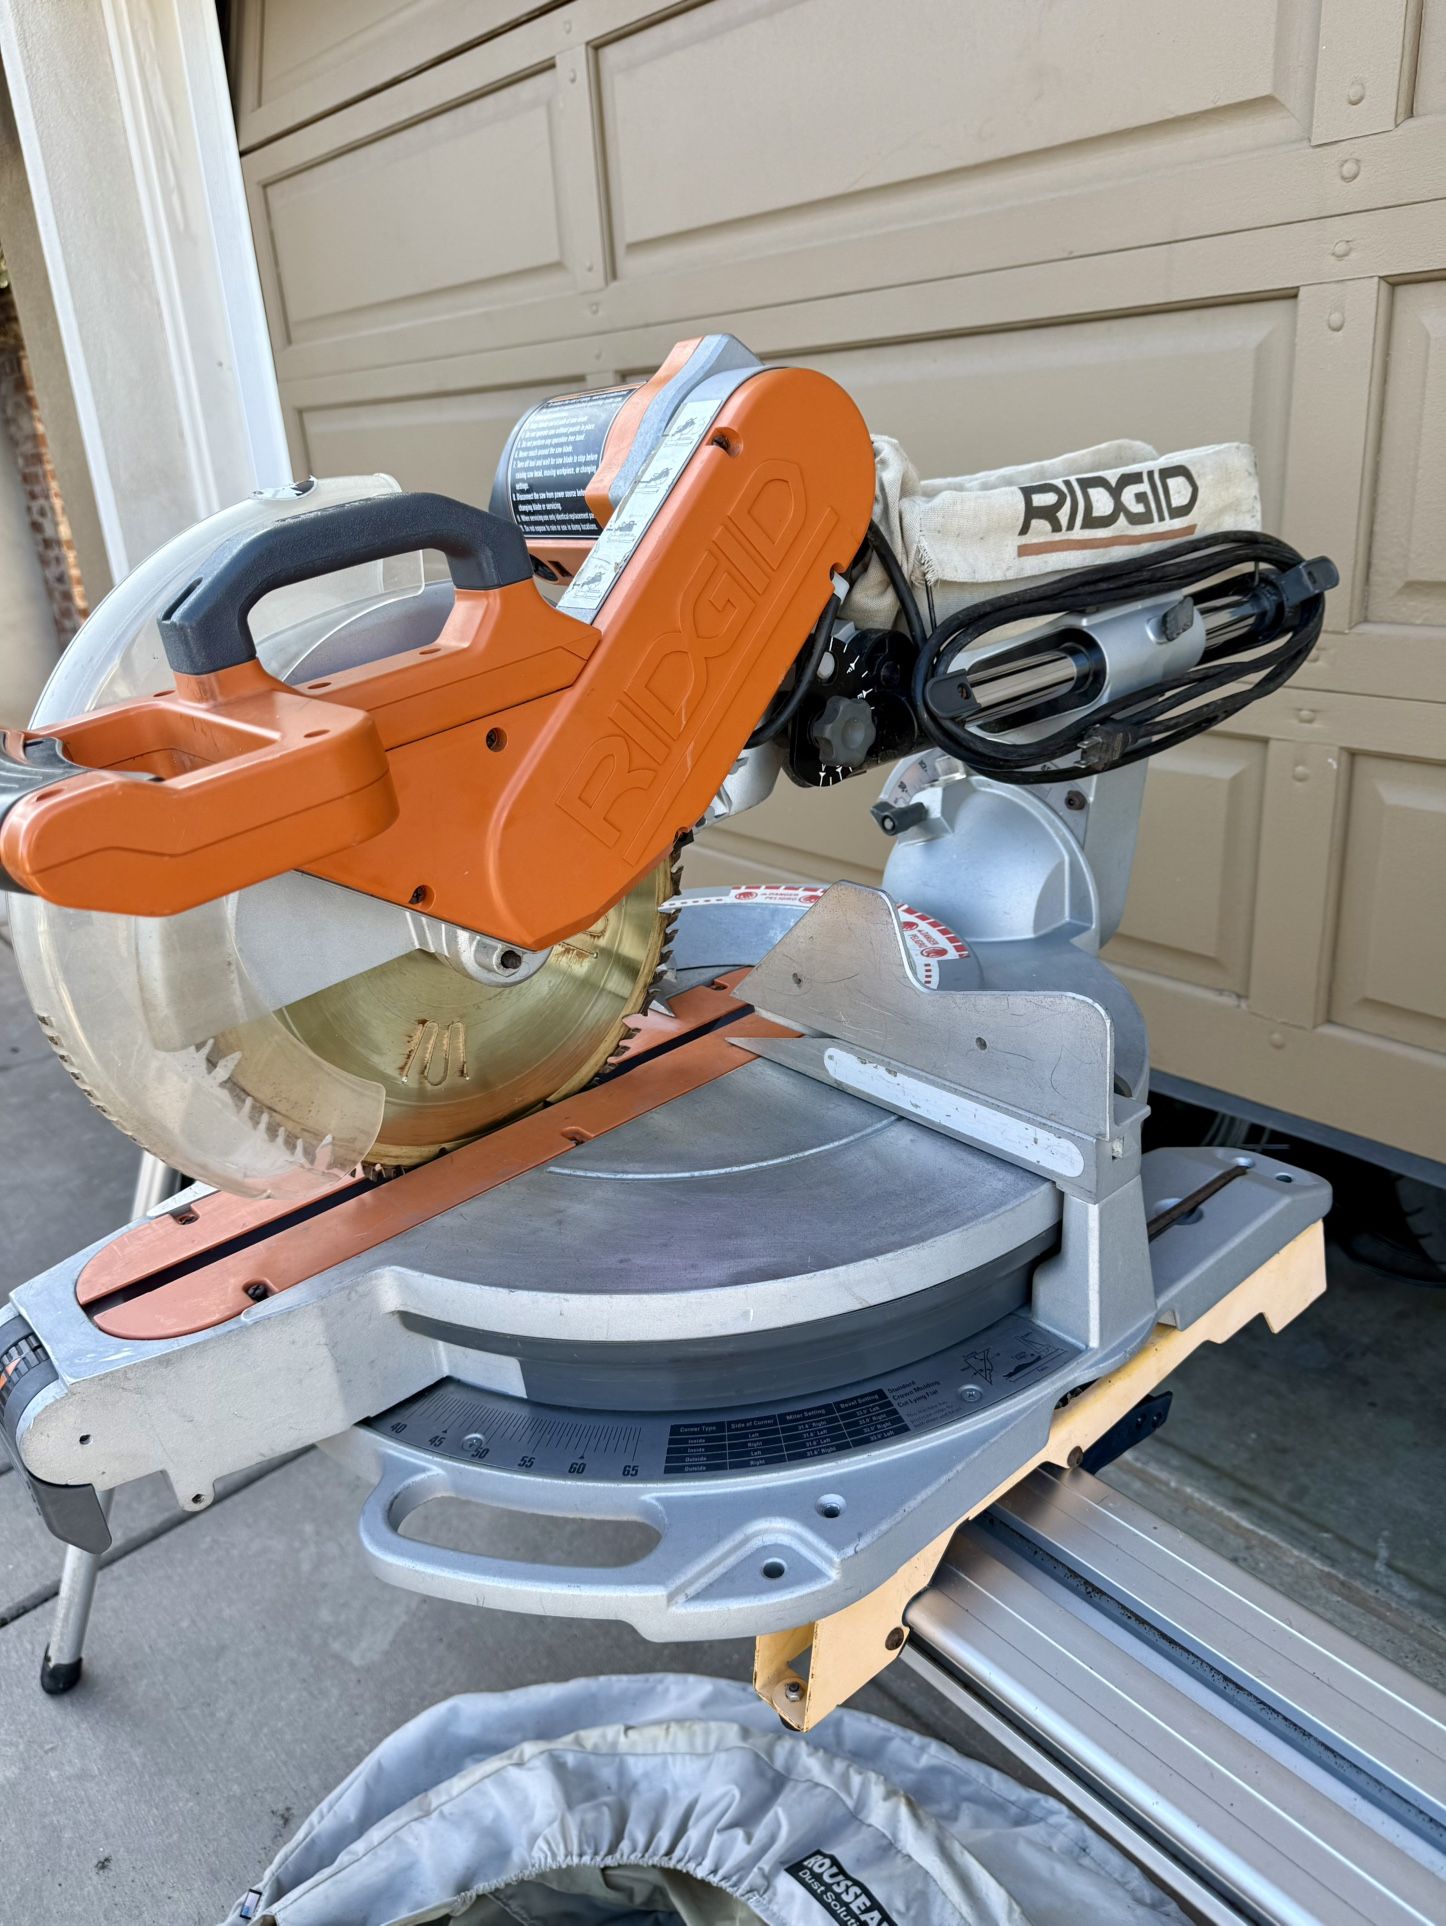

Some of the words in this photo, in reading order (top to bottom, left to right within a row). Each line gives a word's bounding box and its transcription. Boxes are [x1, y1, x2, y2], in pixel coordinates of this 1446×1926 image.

[1018, 465, 1199, 536] RIDGID
[555, 460, 808, 849] RIDGID
[390, 1421, 408, 1435] 40
[428, 1435, 446, 1448] 45
[470, 1447, 490, 1460] 50
[518, 1455, 536, 1469] 55
[567, 1462, 586, 1475] 60
[622, 1464, 640, 1477] 65
[798, 1868, 826, 1894] Dust
[802, 1854, 889, 1926] ROUSSEA
